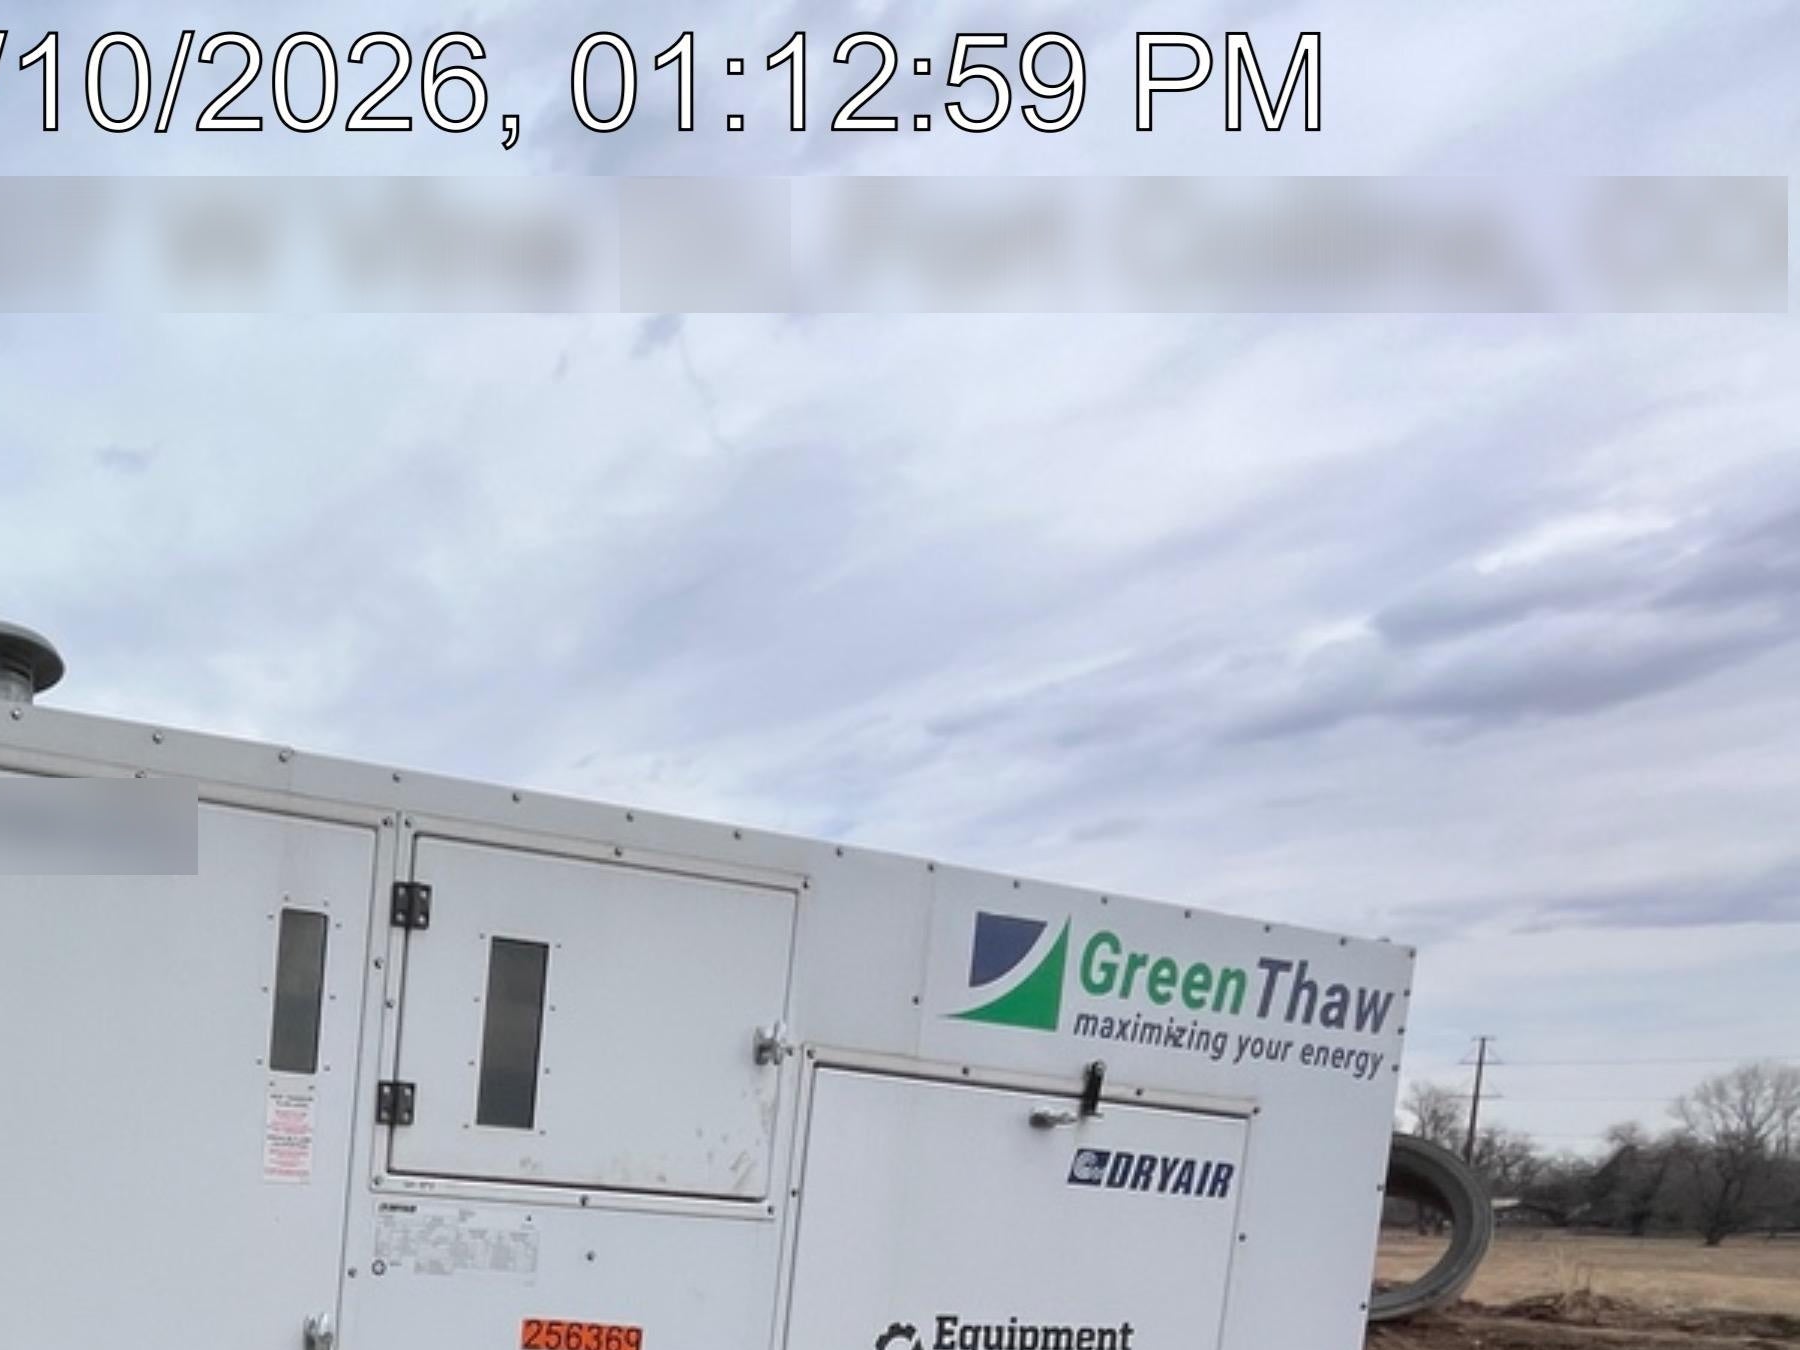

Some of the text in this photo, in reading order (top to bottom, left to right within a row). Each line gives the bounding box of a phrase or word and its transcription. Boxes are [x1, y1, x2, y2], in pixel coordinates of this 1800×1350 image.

[1074, 1011, 1384, 1080] maximizing your energy
[1106, 1152, 1234, 1198] DRYAIR
